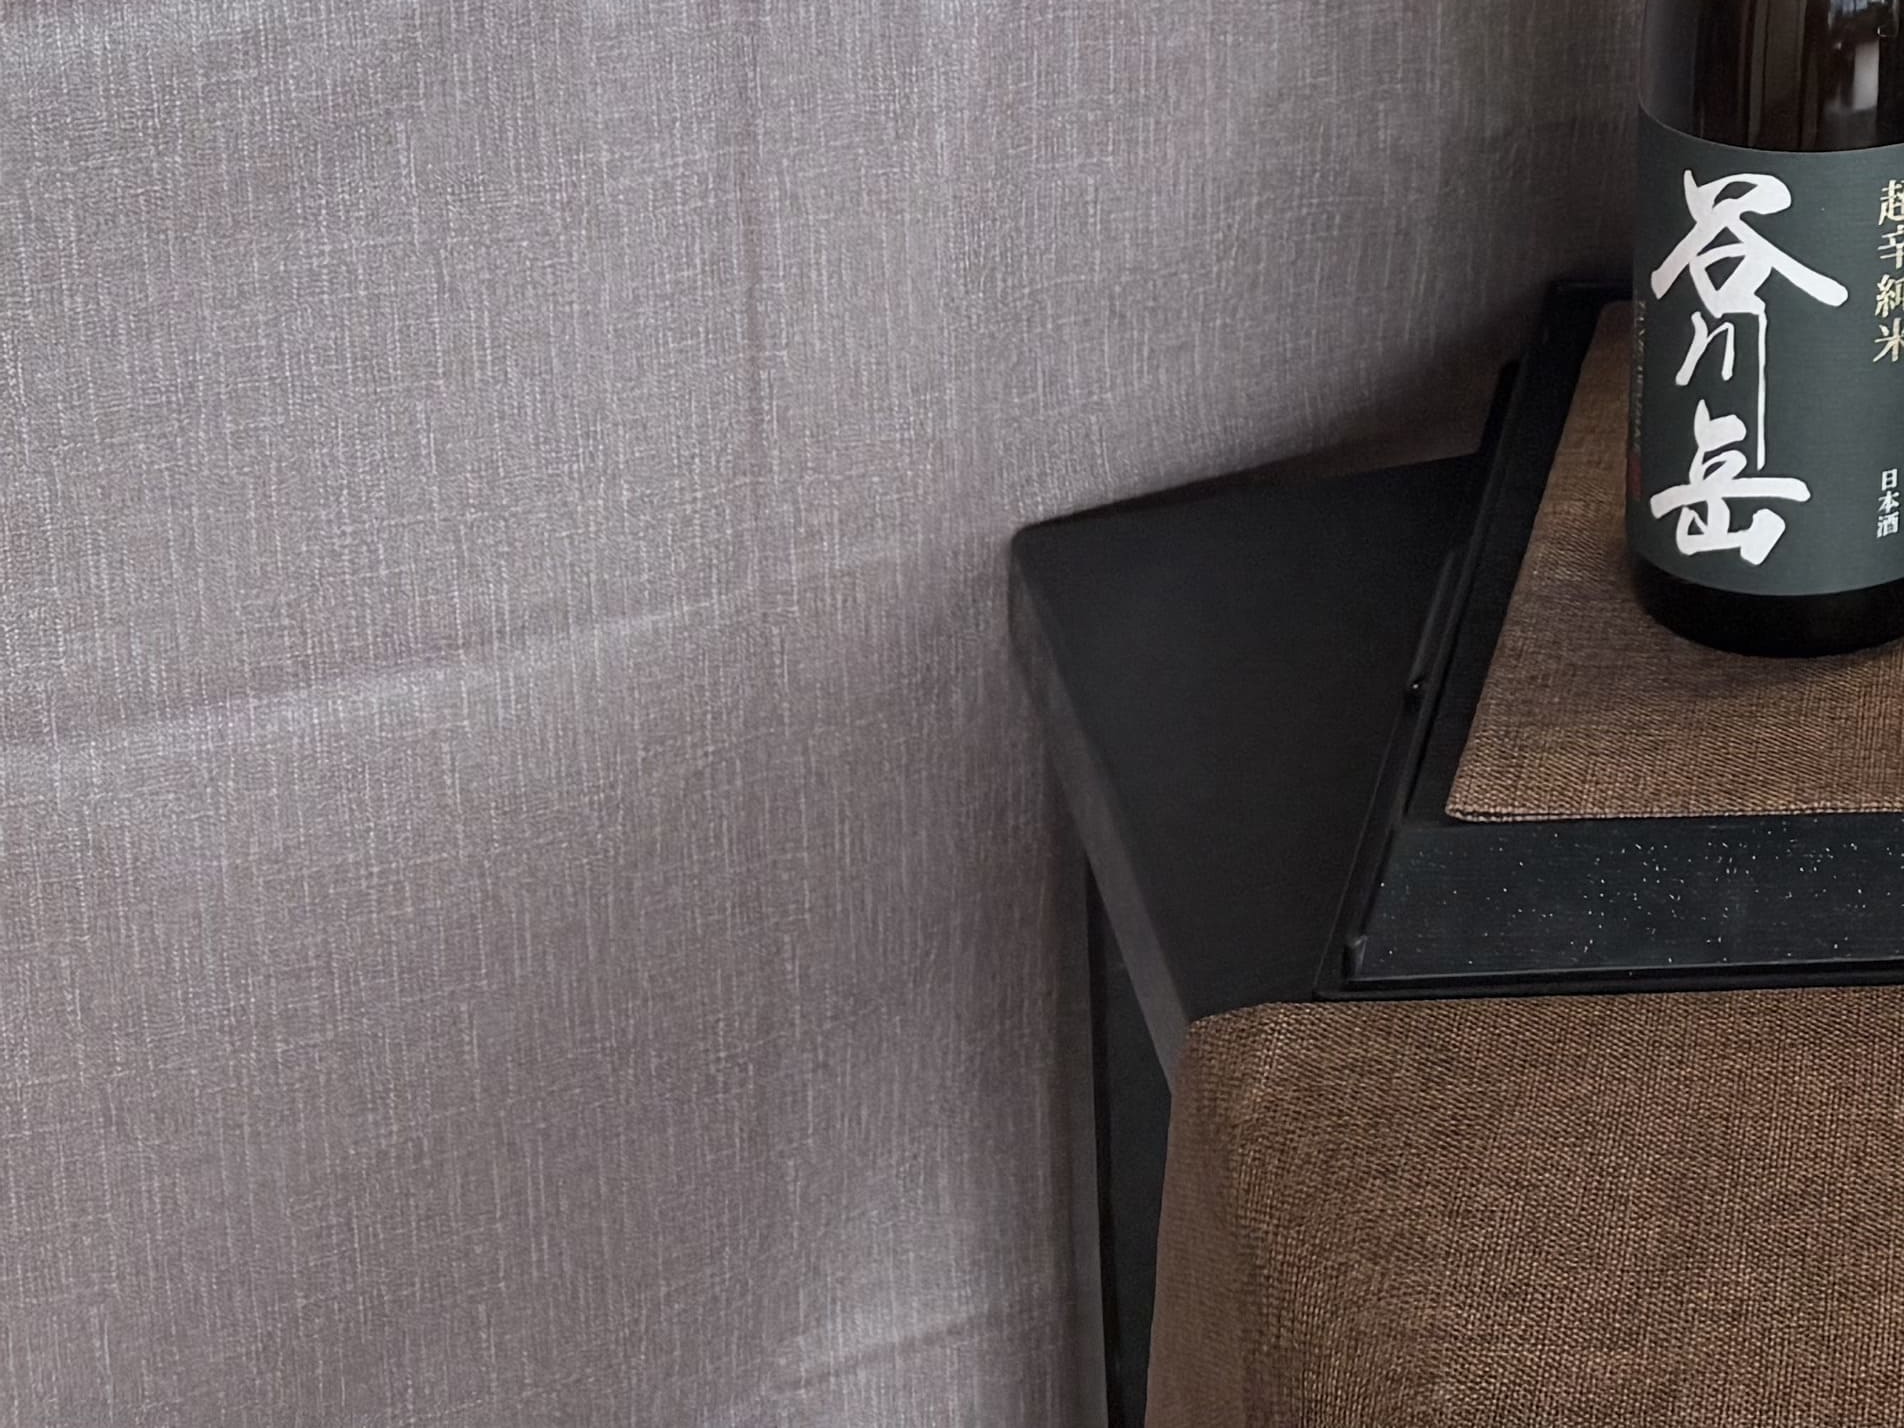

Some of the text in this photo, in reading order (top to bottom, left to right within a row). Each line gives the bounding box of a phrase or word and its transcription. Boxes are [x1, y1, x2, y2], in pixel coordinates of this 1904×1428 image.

[1650, 169, 1849, 566] 谷川岳
[1876, 468, 1899, 538] 日本酒
